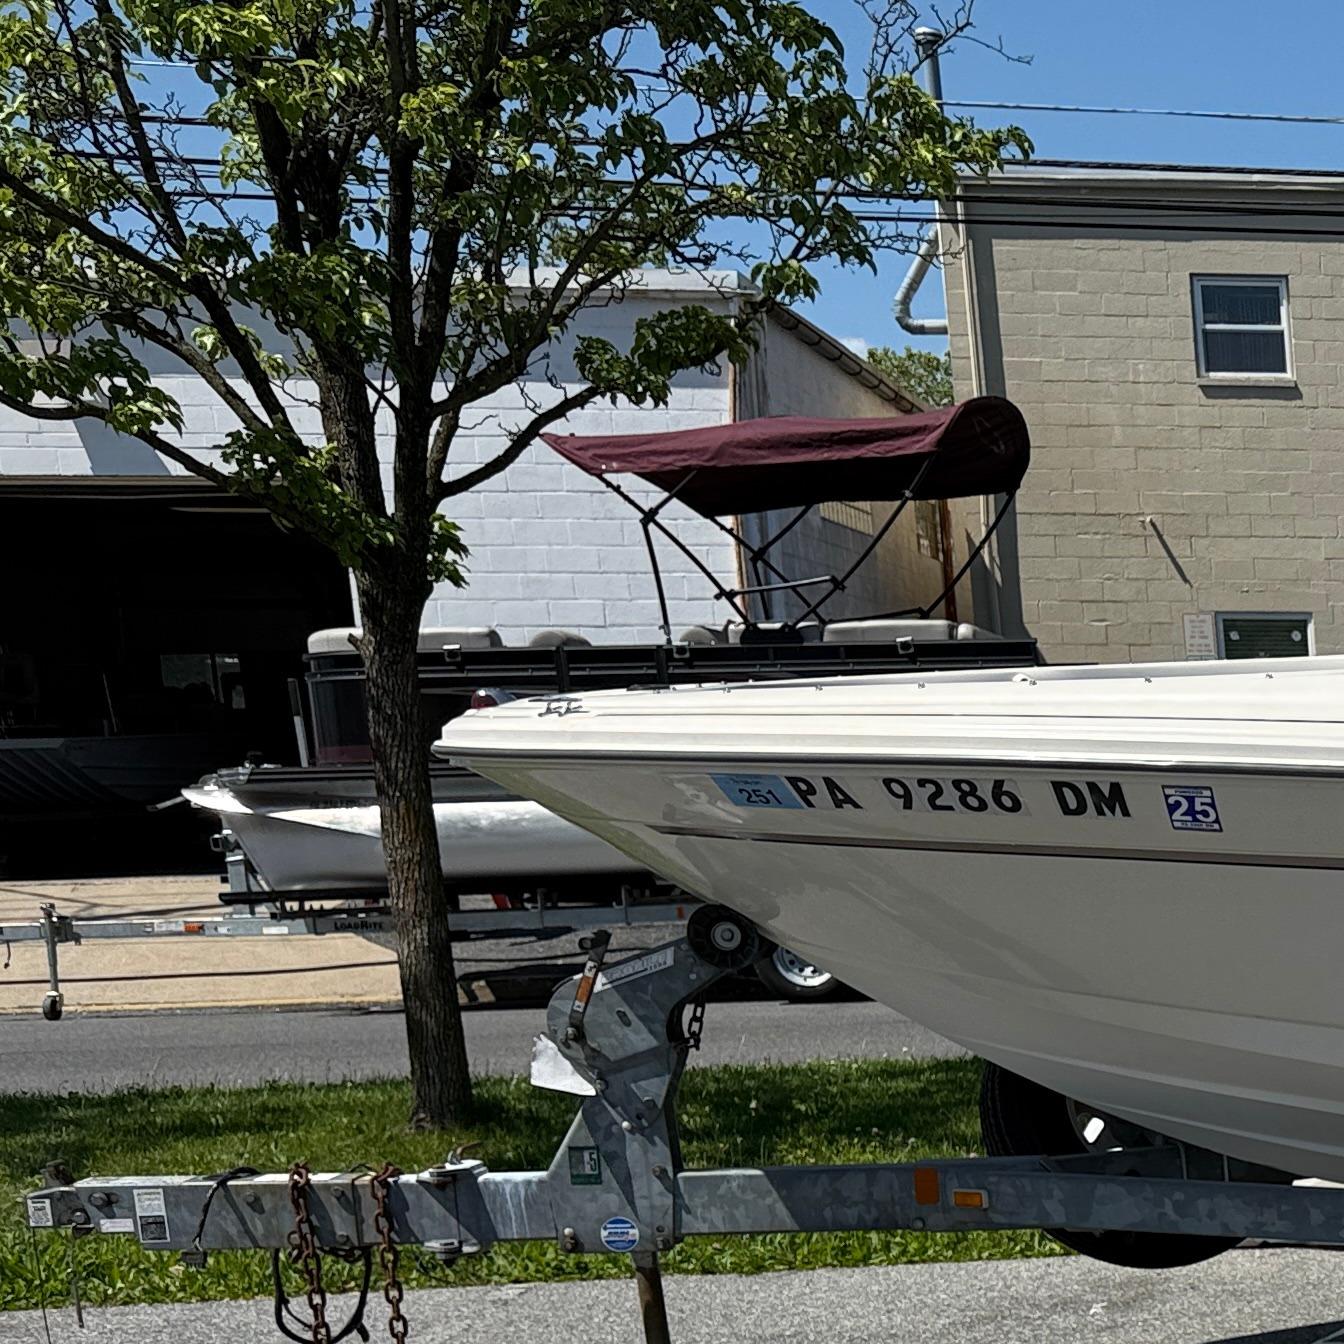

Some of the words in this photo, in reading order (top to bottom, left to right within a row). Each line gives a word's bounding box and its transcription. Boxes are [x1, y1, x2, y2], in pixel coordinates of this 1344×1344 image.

[739, 788, 783, 805] 251
[784, 775, 863, 809] PA
[882, 777, 1023, 814] 9286
[1050, 780, 1132, 818] DM
[1168, 796, 1217, 823] 25
